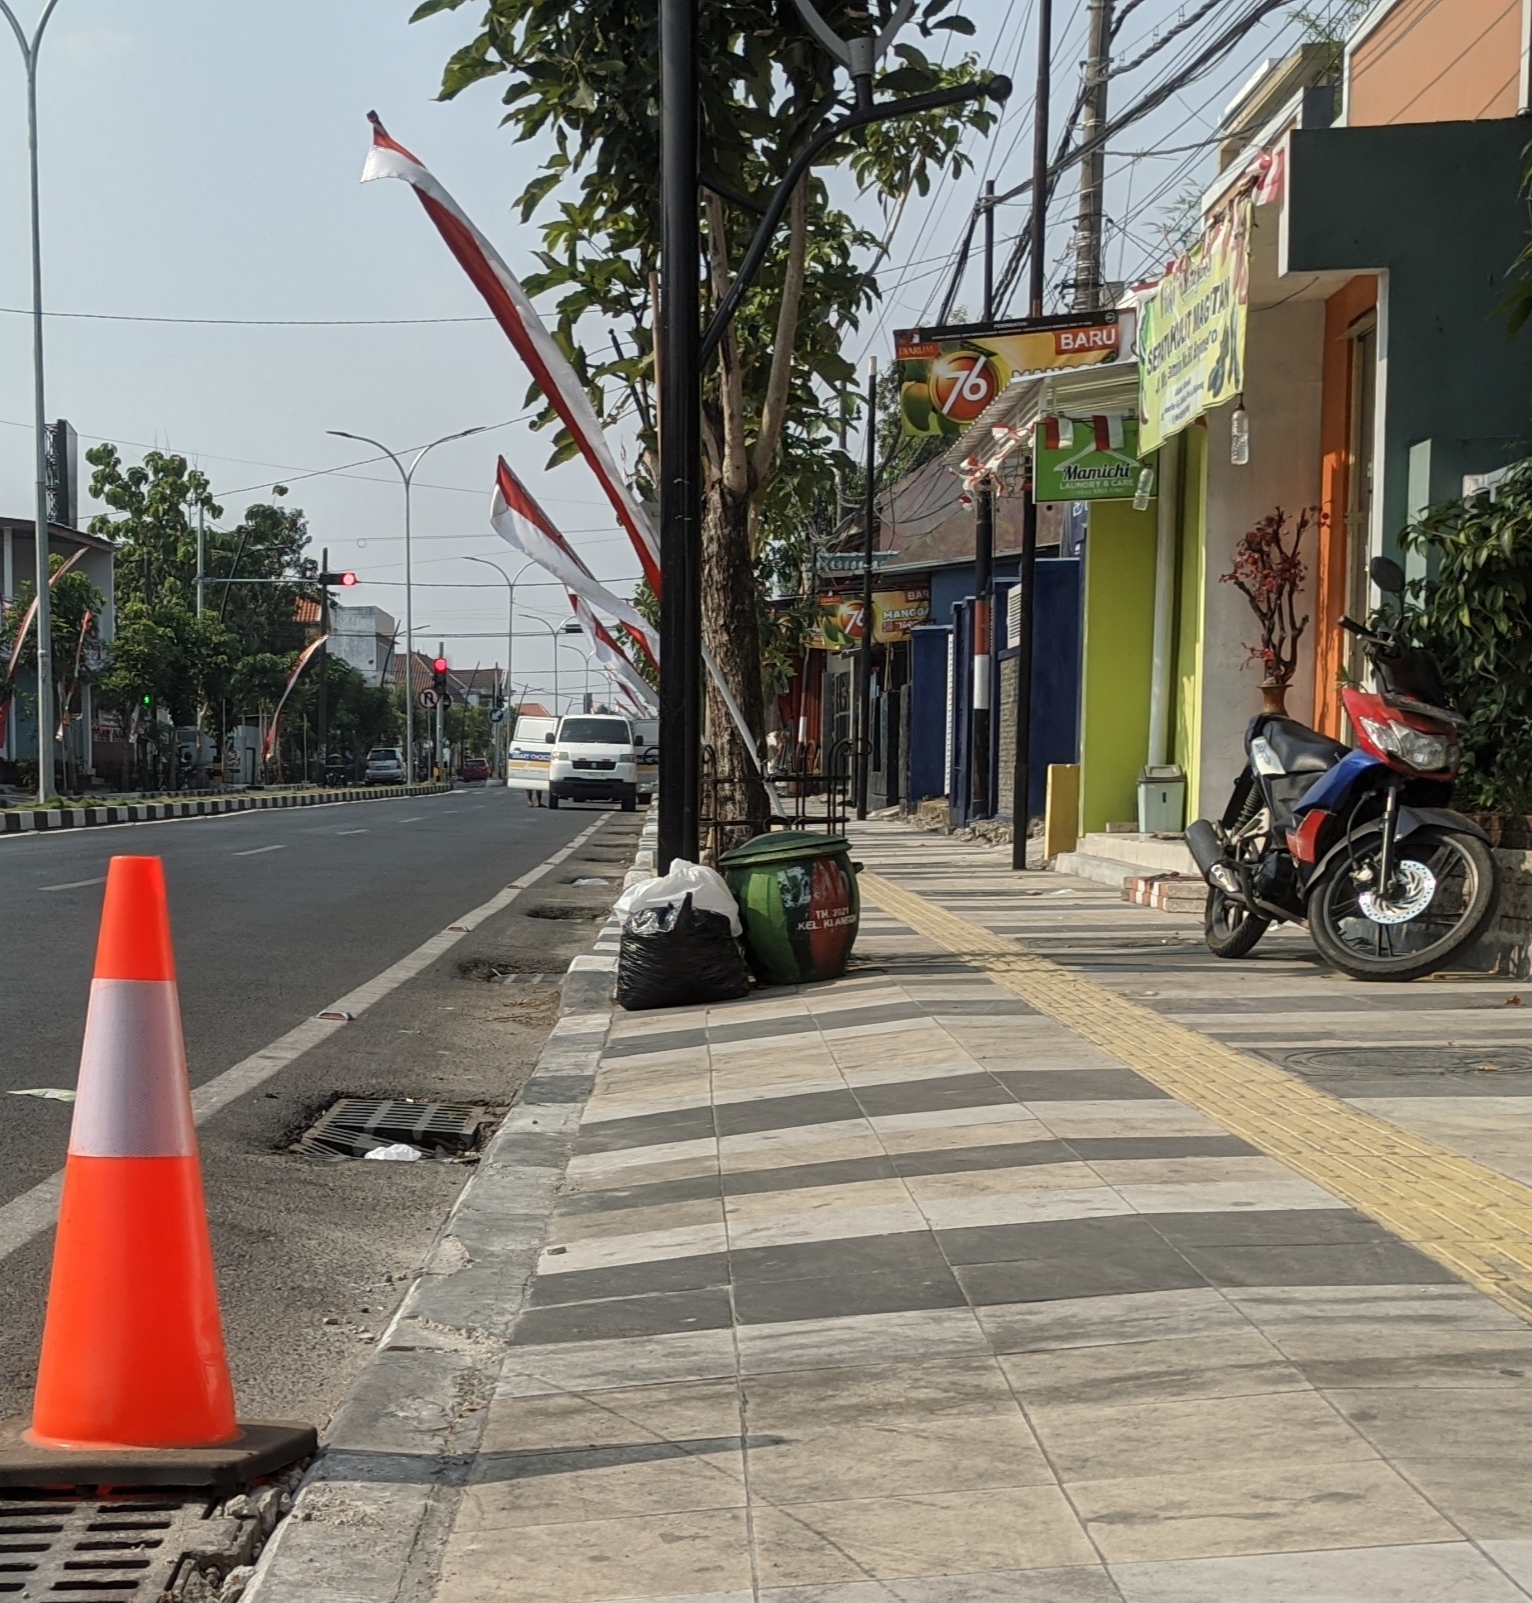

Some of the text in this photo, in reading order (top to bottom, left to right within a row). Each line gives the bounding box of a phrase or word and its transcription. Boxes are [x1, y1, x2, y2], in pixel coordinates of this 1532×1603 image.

[1060, 328, 1116, 350] BARU
[940, 354, 989, 416] 76
[1062, 462, 1131, 481] Mamichi
[1059, 481, 1100, 490] LAUNDRY
[907, 590, 930, 601] BAR
